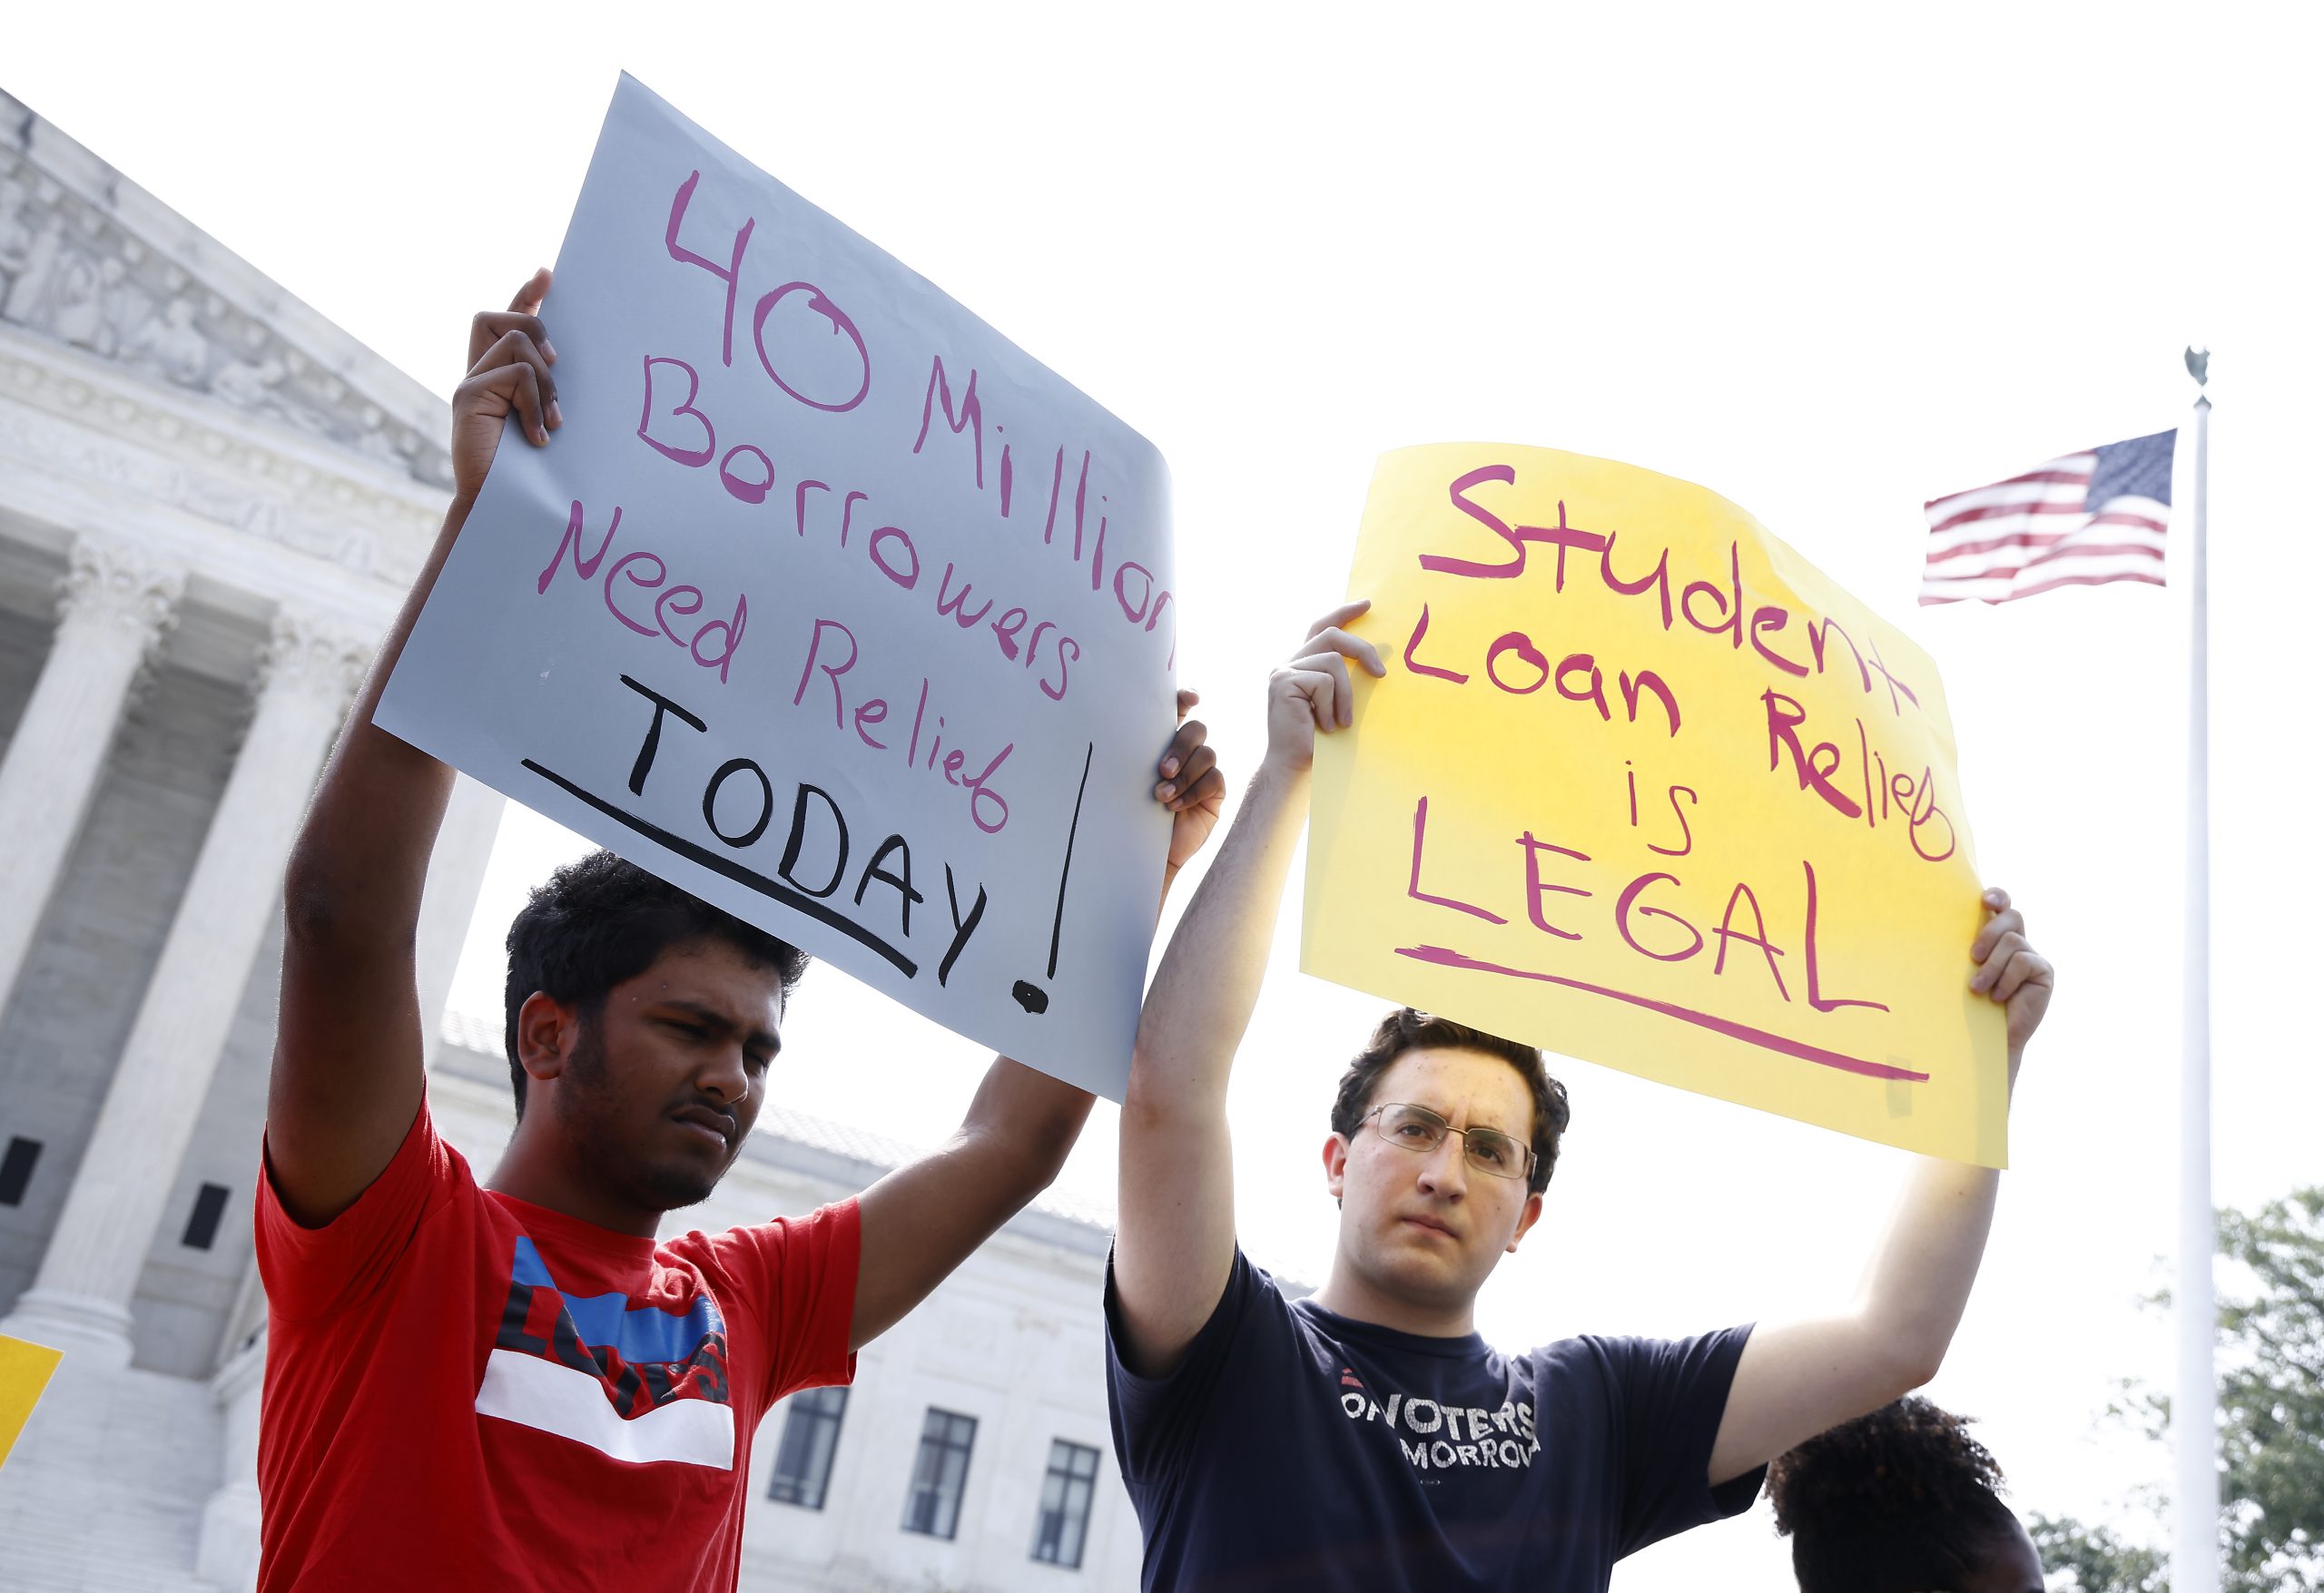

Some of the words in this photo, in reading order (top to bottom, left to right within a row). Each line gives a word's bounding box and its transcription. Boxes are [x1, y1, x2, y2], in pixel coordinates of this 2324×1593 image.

[637, 355, 1080, 701] Borrowers
[665, 169, 871, 412] 40
[914, 354, 1177, 672] Million
[537, 500, 748, 683] Need
[793, 619, 1014, 834] Relief
[1419, 464, 1920, 717] Student
[1403, 602, 1681, 737] Loan
[1761, 687, 1955, 861] Relief
[1623, 760, 1699, 857] is
[1408, 795, 1890, 1013] LEGAL
